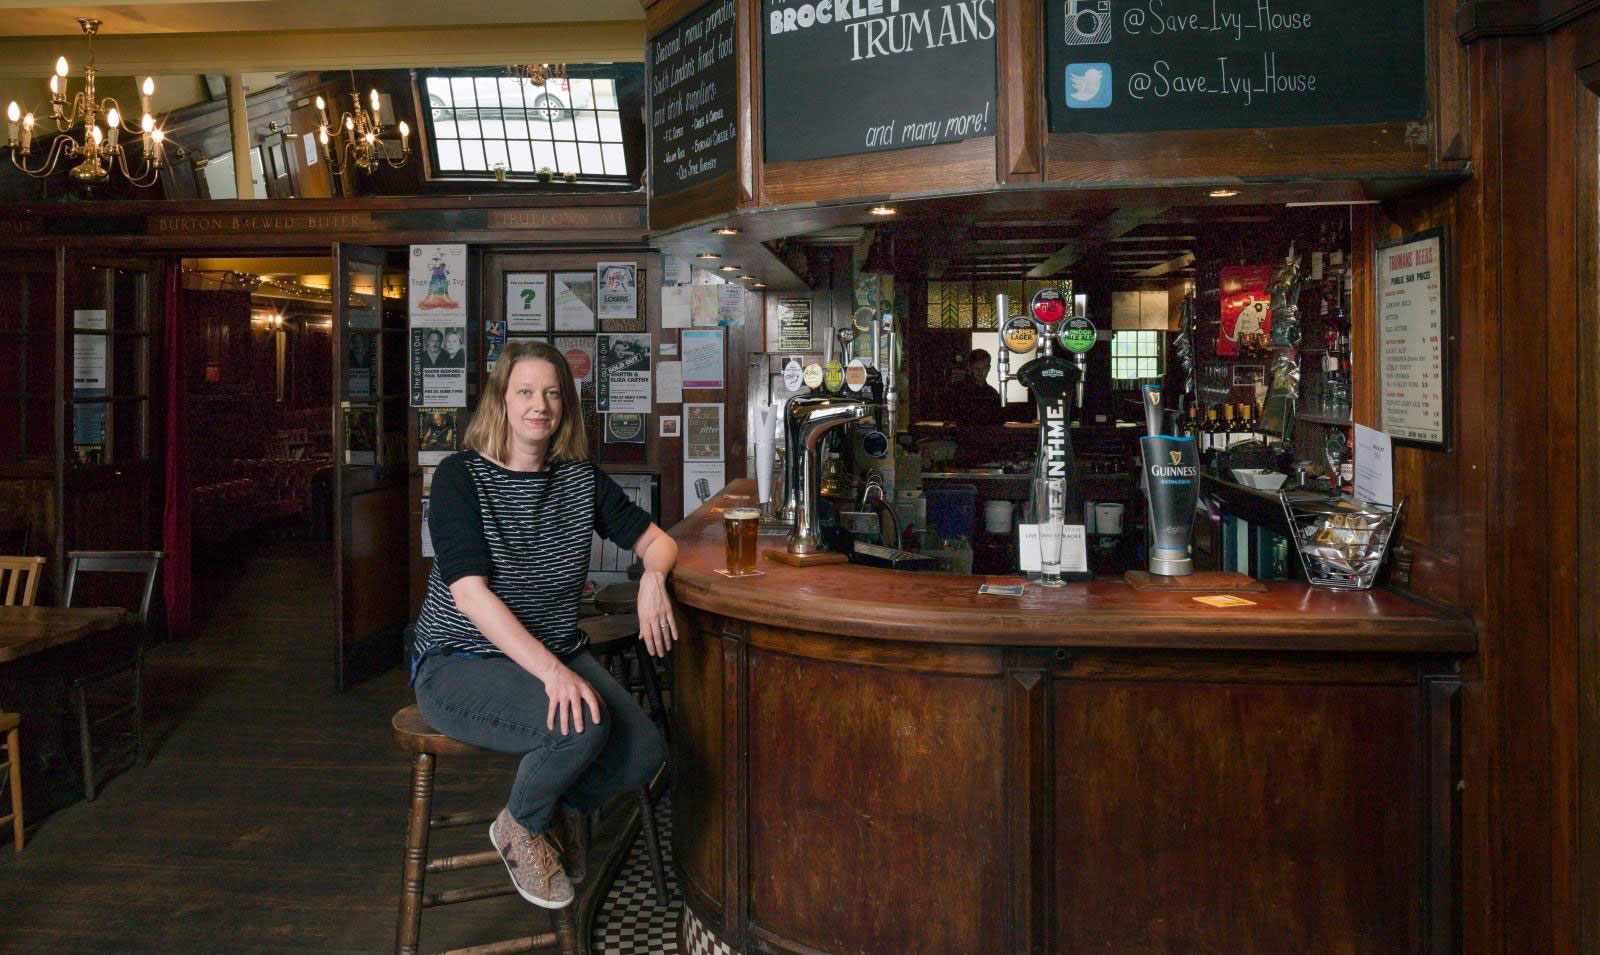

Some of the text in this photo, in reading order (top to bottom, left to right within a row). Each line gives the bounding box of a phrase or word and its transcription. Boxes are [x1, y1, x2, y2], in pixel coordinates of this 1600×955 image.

[656, 27, 680, 64] Seasonal
[684, 20, 703, 46] menus
[718, 24, 733, 60] food
[845, 0, 995, 60] TRUMANS
[1128, 52, 1316, 105] @Save_Ivy_House
[866, 102, 990, 146] and many more!
[160, 218, 222, 231] BURTON
[232, 217, 294, 230] BREWED
[308, 216, 360, 228] BITTER
[1416, 247, 1432, 266] BEERS
[608, 356, 639, 374] SOLD OUT
[1152, 464, 1197, 476] GUINNESS
